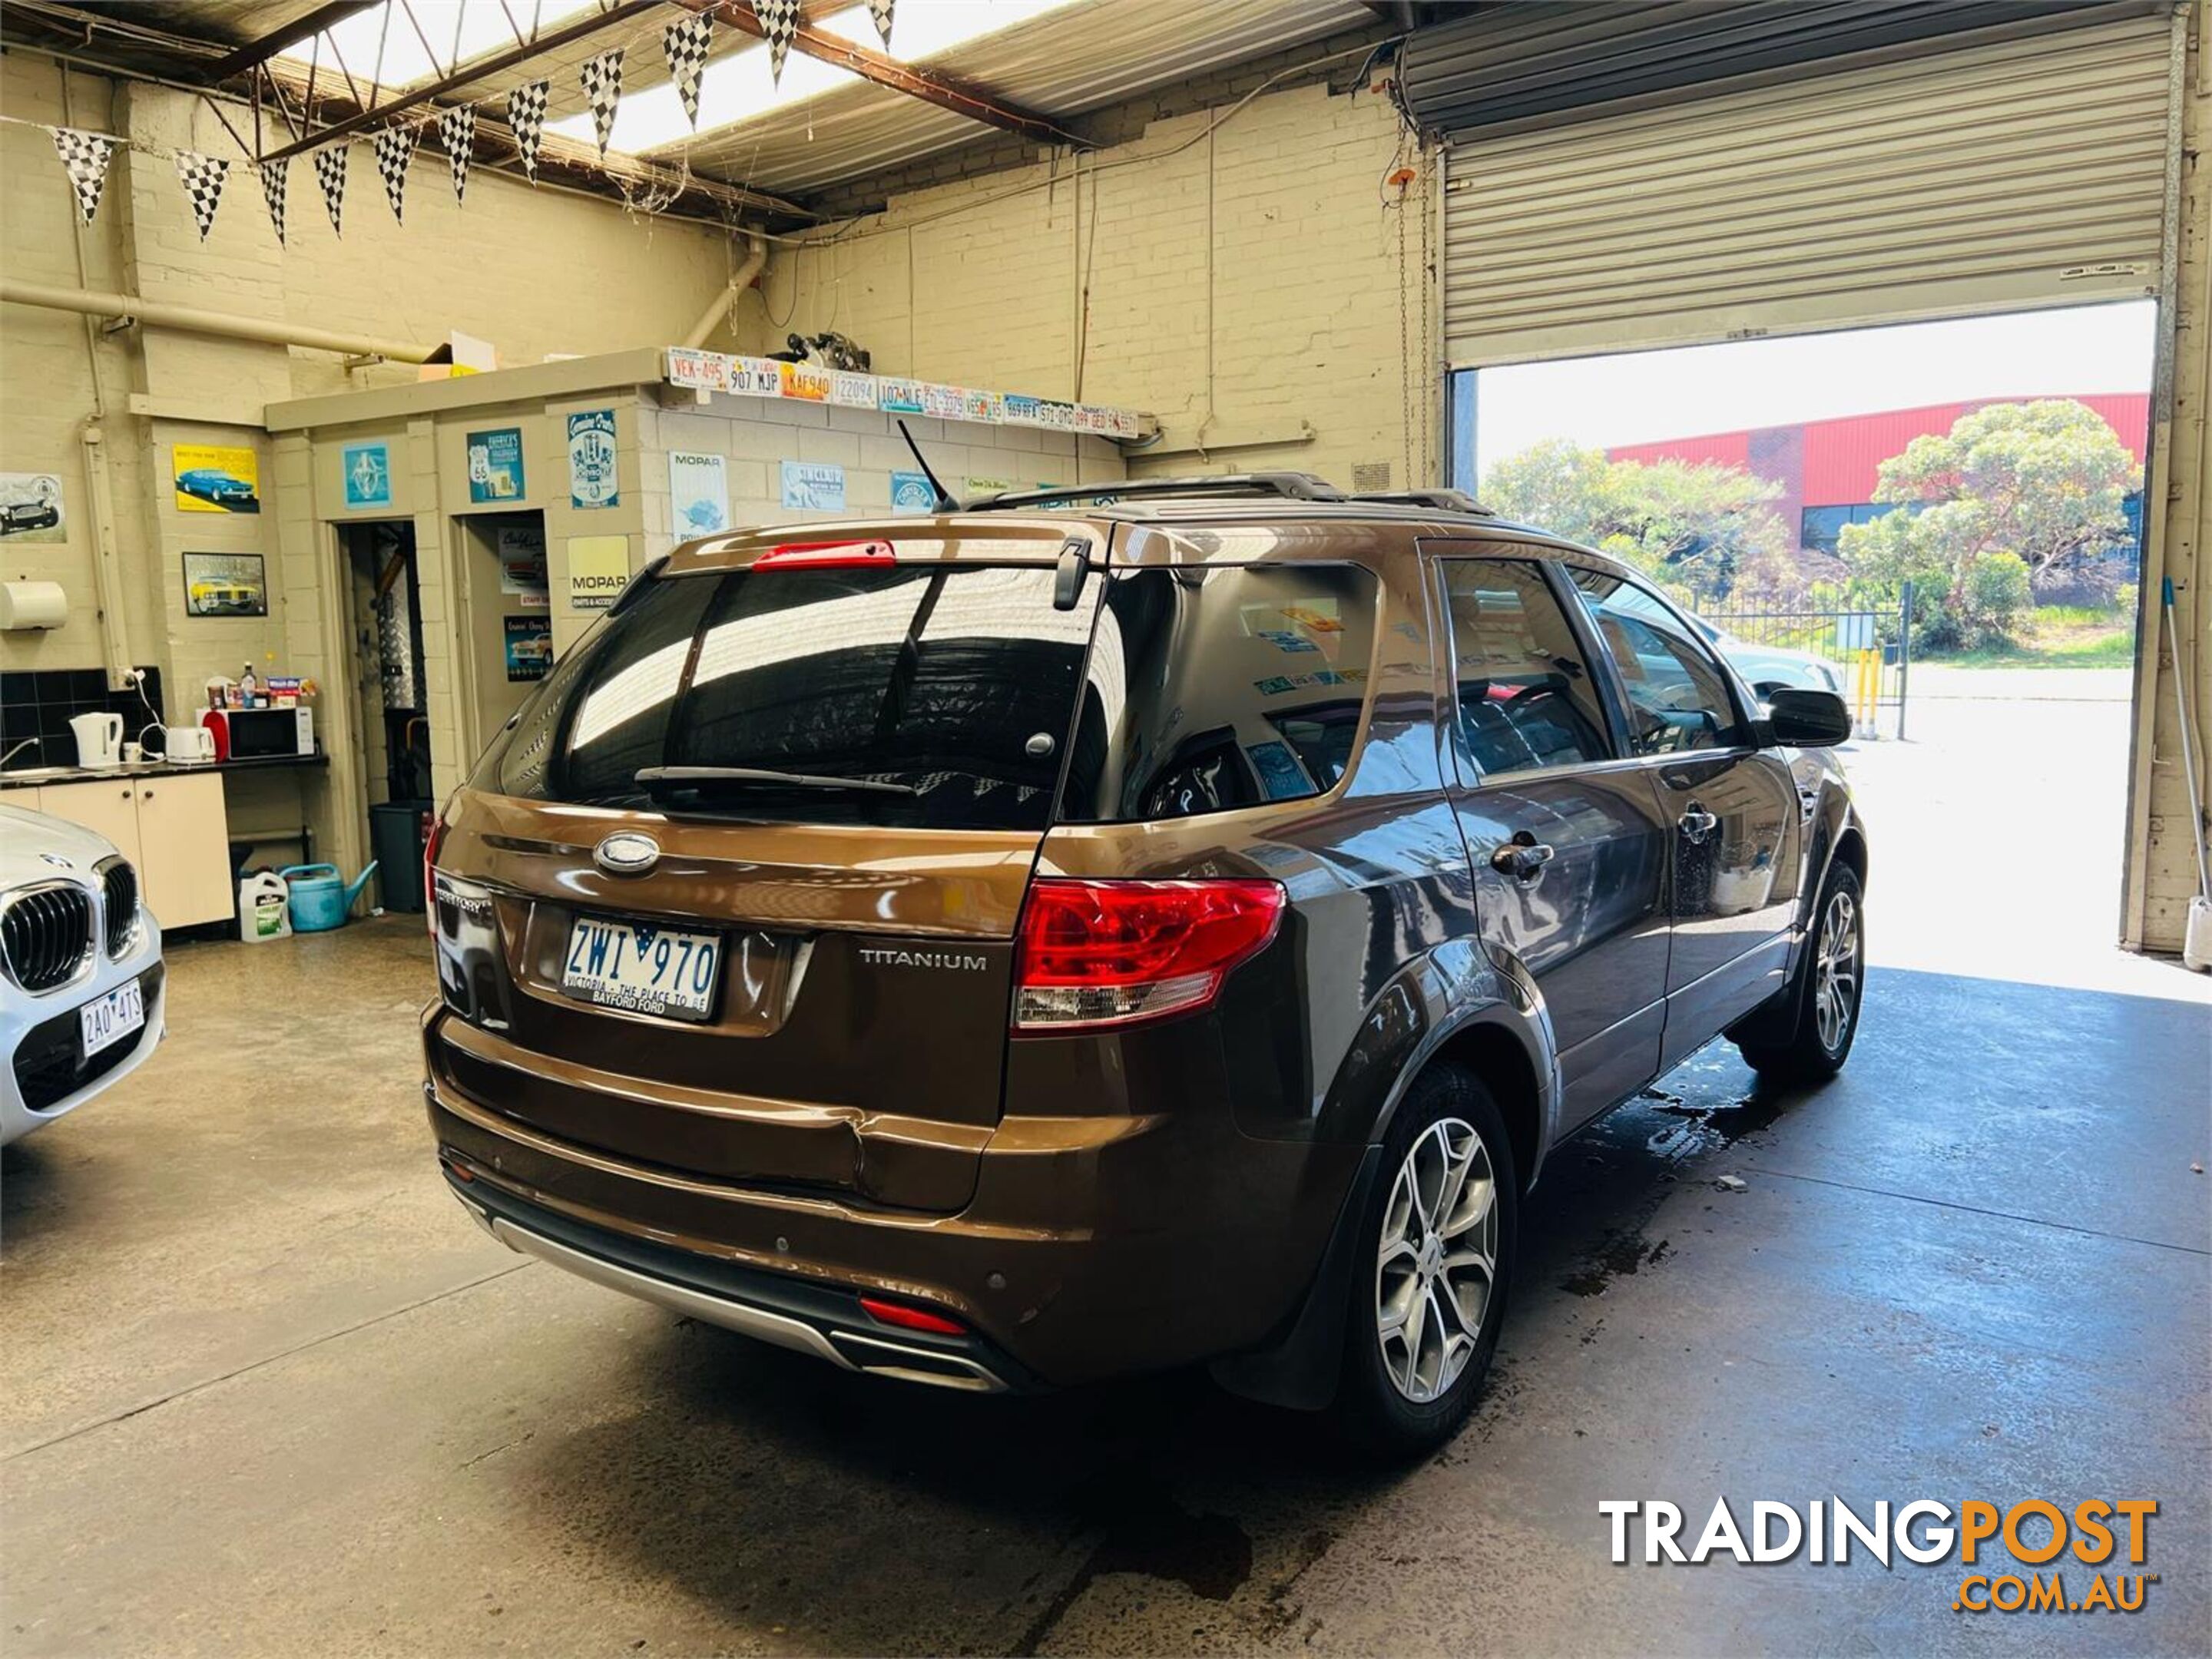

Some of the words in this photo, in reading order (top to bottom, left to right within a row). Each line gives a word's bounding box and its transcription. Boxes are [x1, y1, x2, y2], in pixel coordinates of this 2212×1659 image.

[731, 371, 751, 389] 907
[758, 373, 777, 391] MJP
[475, 465, 487, 479] 66
[675, 455, 720, 467] MOPAR
[572, 576, 627, 589] MOPAR
[568, 924, 628, 980] ZWI
[651, 937, 714, 995] 970
[859, 949, 986, 971] TITANIUM
[568, 975, 606, 992] VICTORIA
[620, 983, 637, 996] THE
[641, 987, 670, 1004] PLACE
[674, 993, 687, 1007] TO
[692, 997, 705, 1012] BE
[593, 990, 636, 1009] BAYFORD
[637, 999, 665, 1015] FORD
[119, 987, 141, 1023] 4TS
